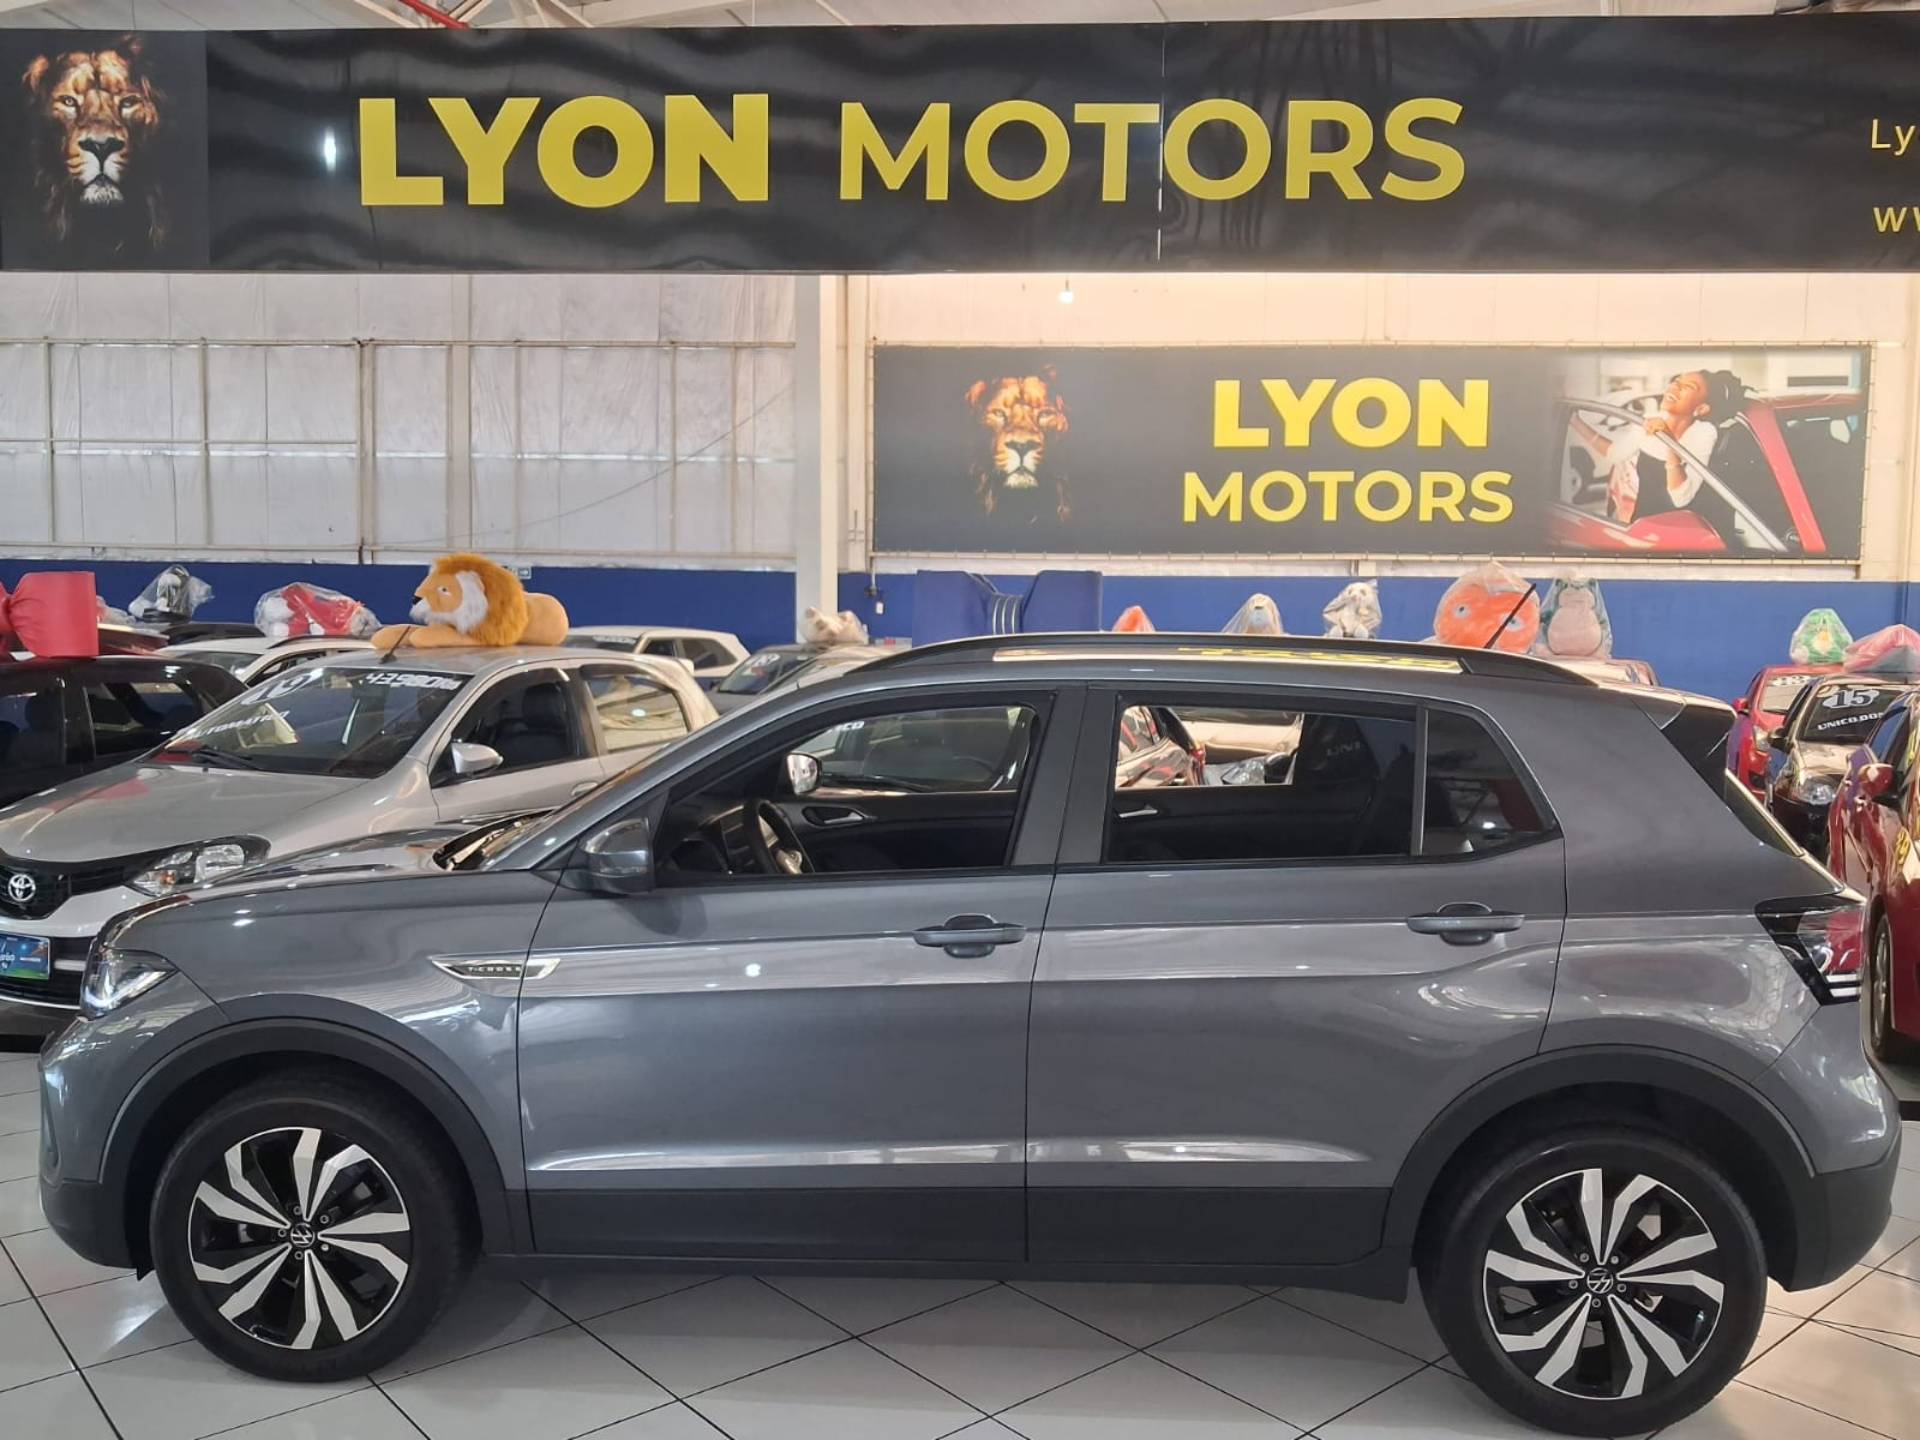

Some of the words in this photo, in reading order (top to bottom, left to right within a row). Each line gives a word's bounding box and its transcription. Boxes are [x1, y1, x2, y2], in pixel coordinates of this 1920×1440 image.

[360, 94, 769, 208] LYON
[839, 97, 1466, 202] MOTORS
[1873, 206, 1920, 233] w
[1213, 377, 1490, 448] LYON
[1183, 469, 1513, 523] MOTORS
[1829, 688, 1876, 708] 15
